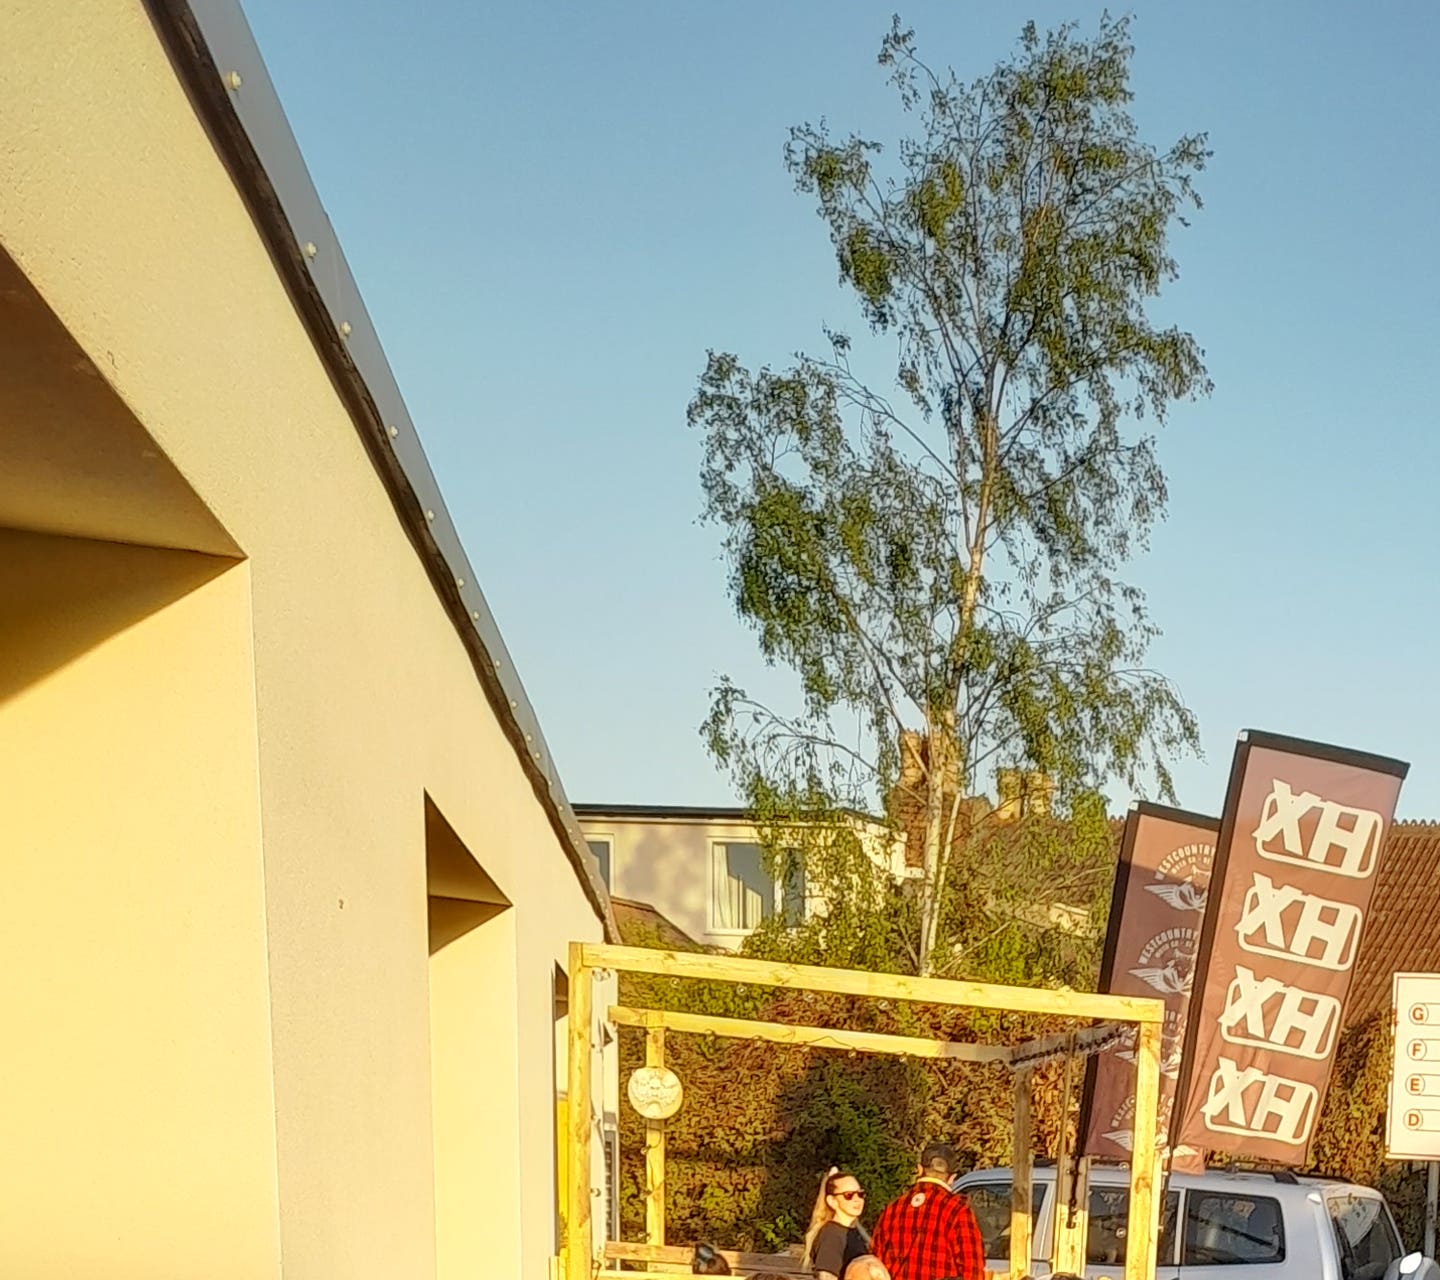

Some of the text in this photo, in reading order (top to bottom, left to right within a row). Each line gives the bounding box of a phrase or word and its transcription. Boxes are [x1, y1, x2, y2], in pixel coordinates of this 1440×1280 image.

[1412, 1008, 1424, 1021] G
[1412, 1043, 1422, 1057] F
[1410, 1079, 1420, 1091] E
[1408, 1113, 1419, 1126] D
